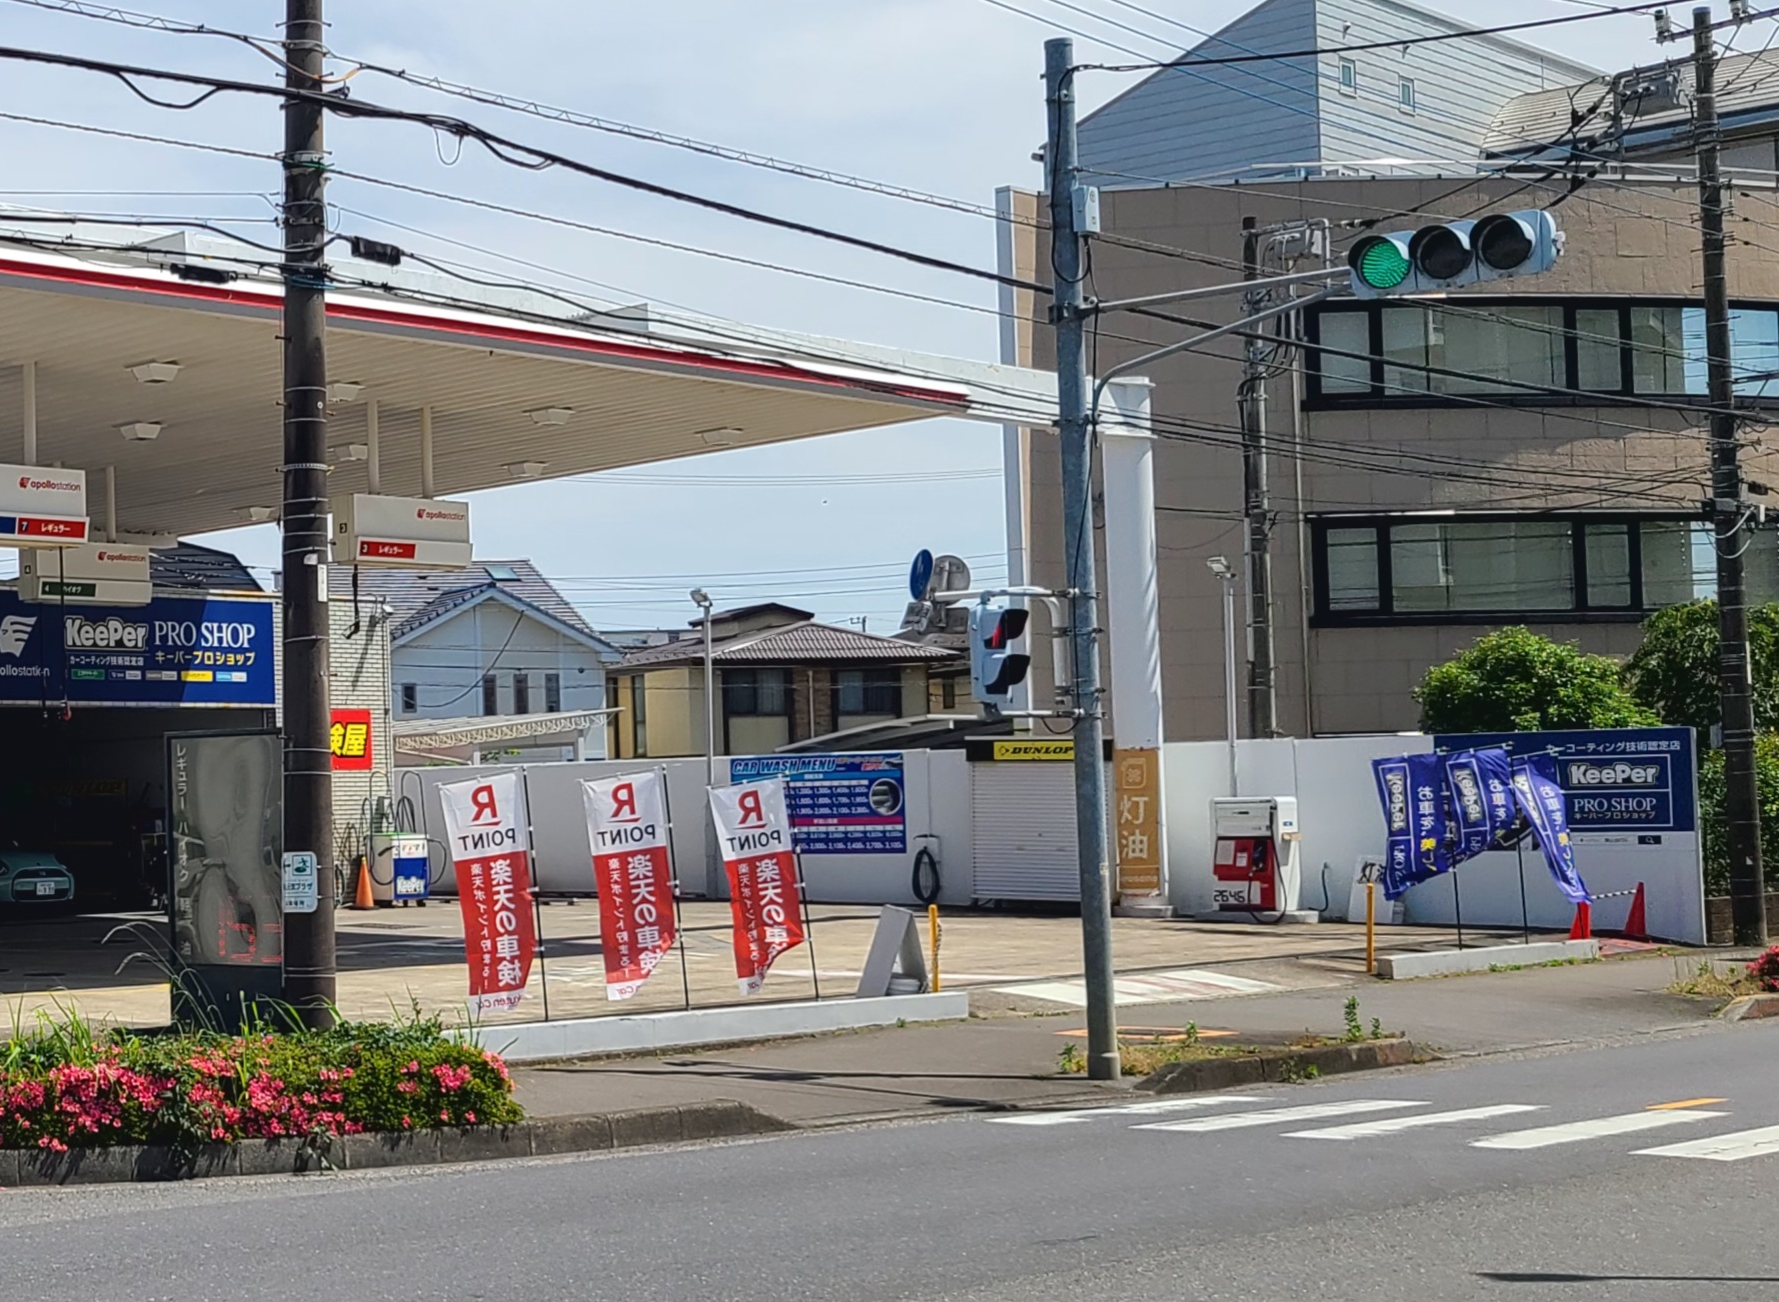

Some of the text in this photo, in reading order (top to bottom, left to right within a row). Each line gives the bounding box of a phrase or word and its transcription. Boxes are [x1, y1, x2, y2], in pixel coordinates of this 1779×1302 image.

[30, 480, 81, 492] apollostation
[65, 617, 148, 649] KeePer
[154, 621, 256, 648] PRO SHOP
[154, 650, 256, 666] キーパープロショップ
[1011, 746, 1074, 755] DUNLOP
[733, 757, 837, 774] CAR WASH MENU
[1569, 763, 1659, 786] KeePer
[1574, 797, 1657, 812] PRO SHOP
[1120, 796, 1150, 860] 灯油
